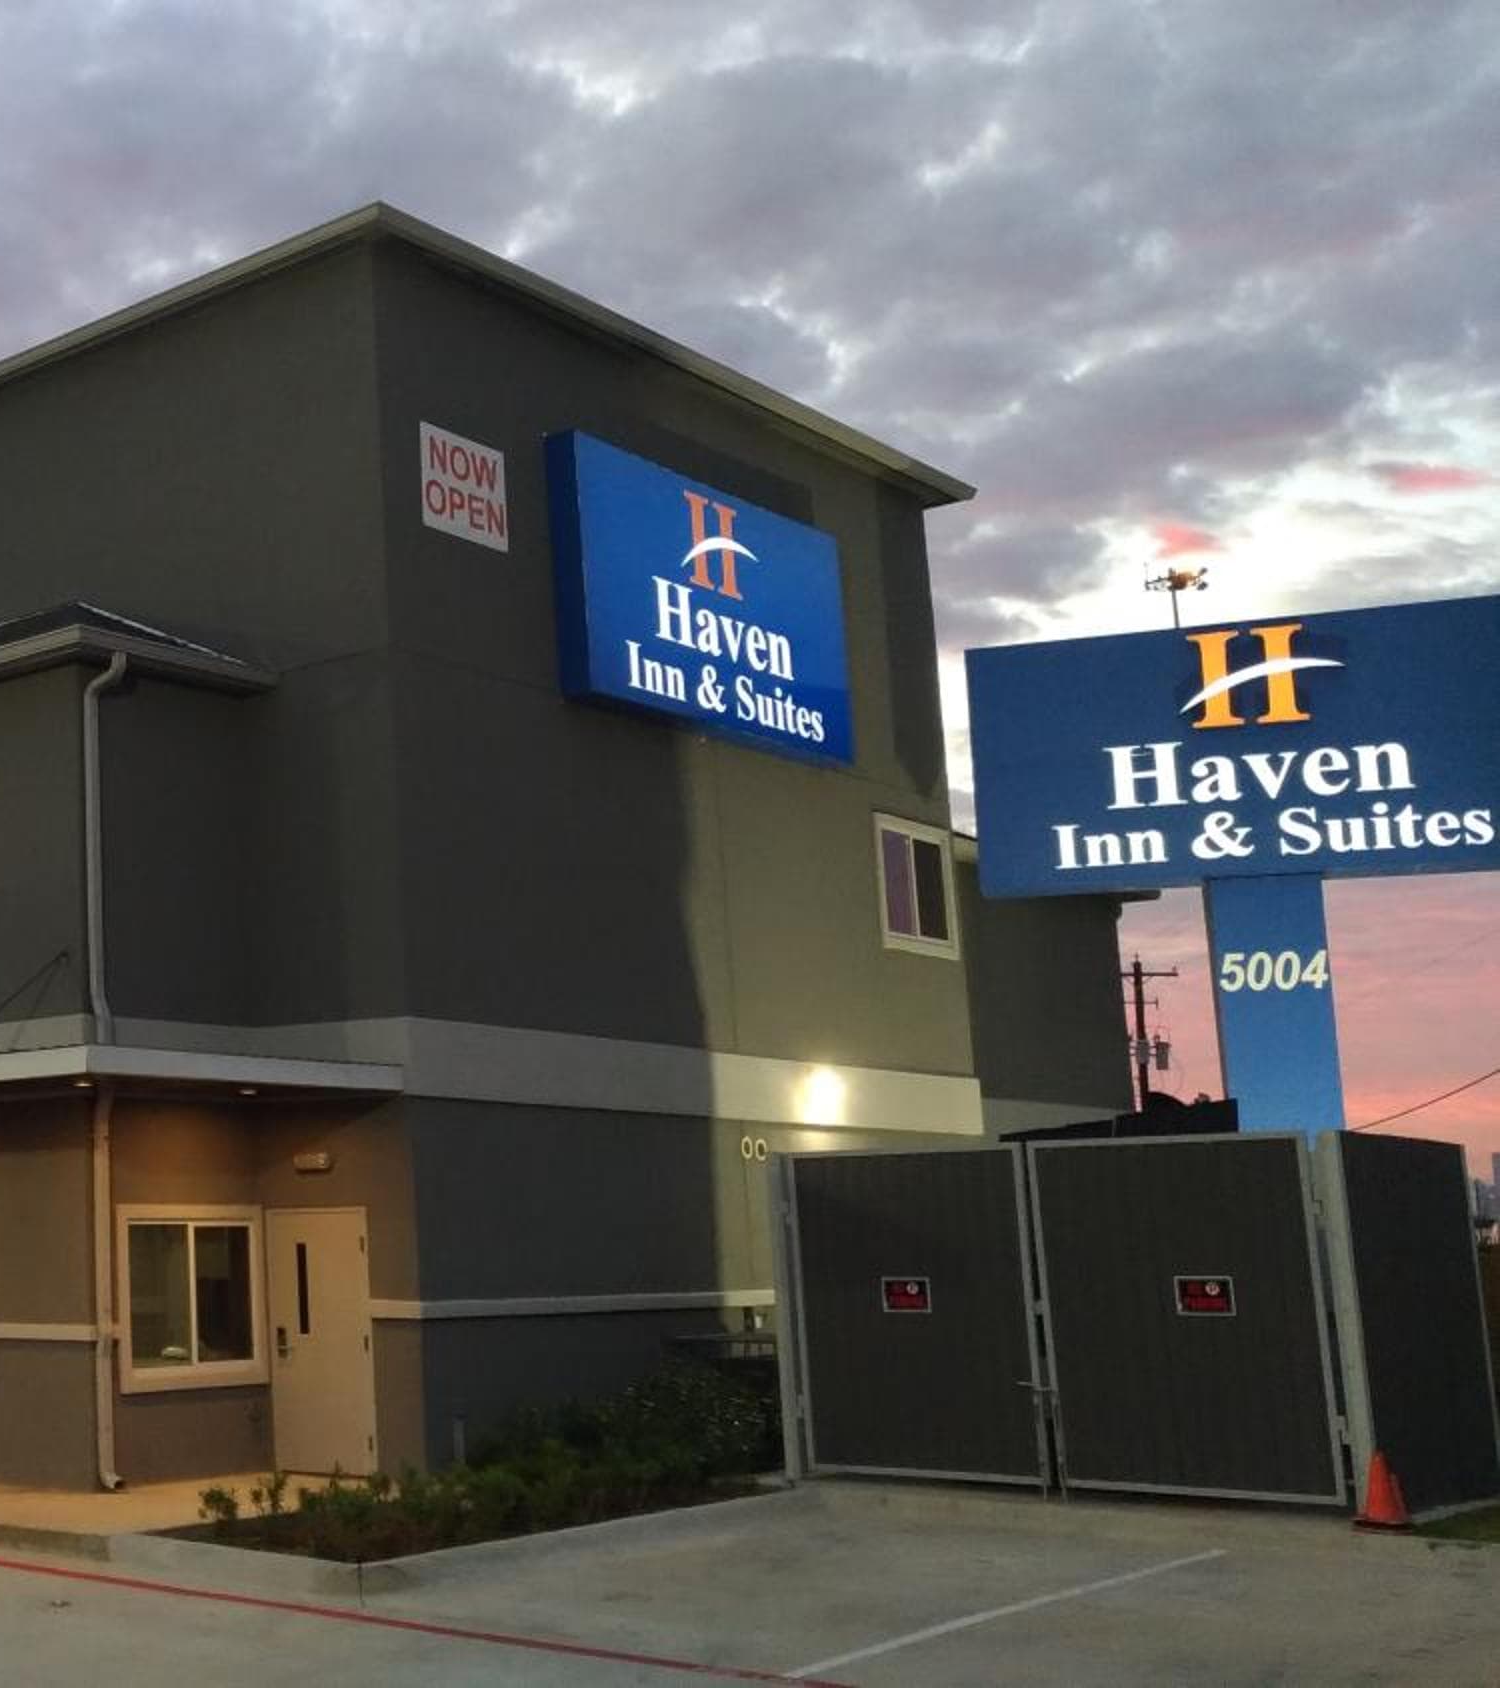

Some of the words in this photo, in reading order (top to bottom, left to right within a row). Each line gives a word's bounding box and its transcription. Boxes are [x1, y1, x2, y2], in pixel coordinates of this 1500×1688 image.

[429, 434, 497, 492] NOW
[426, 479, 504, 537] OPEN
[683, 489, 743, 600] H
[652, 576, 794, 681] Haven
[626, 640, 686, 701] Inn
[697, 664, 727, 713] &
[736, 675, 825, 742] Suites
[1185, 623, 1311, 729] H
[1103, 740, 1416, 810] Haven
[1052, 824, 1169, 870] Inn
[1191, 810, 1254, 859] &
[1278, 802, 1495, 856] Suites
[1220, 950, 1329, 992] 5004
